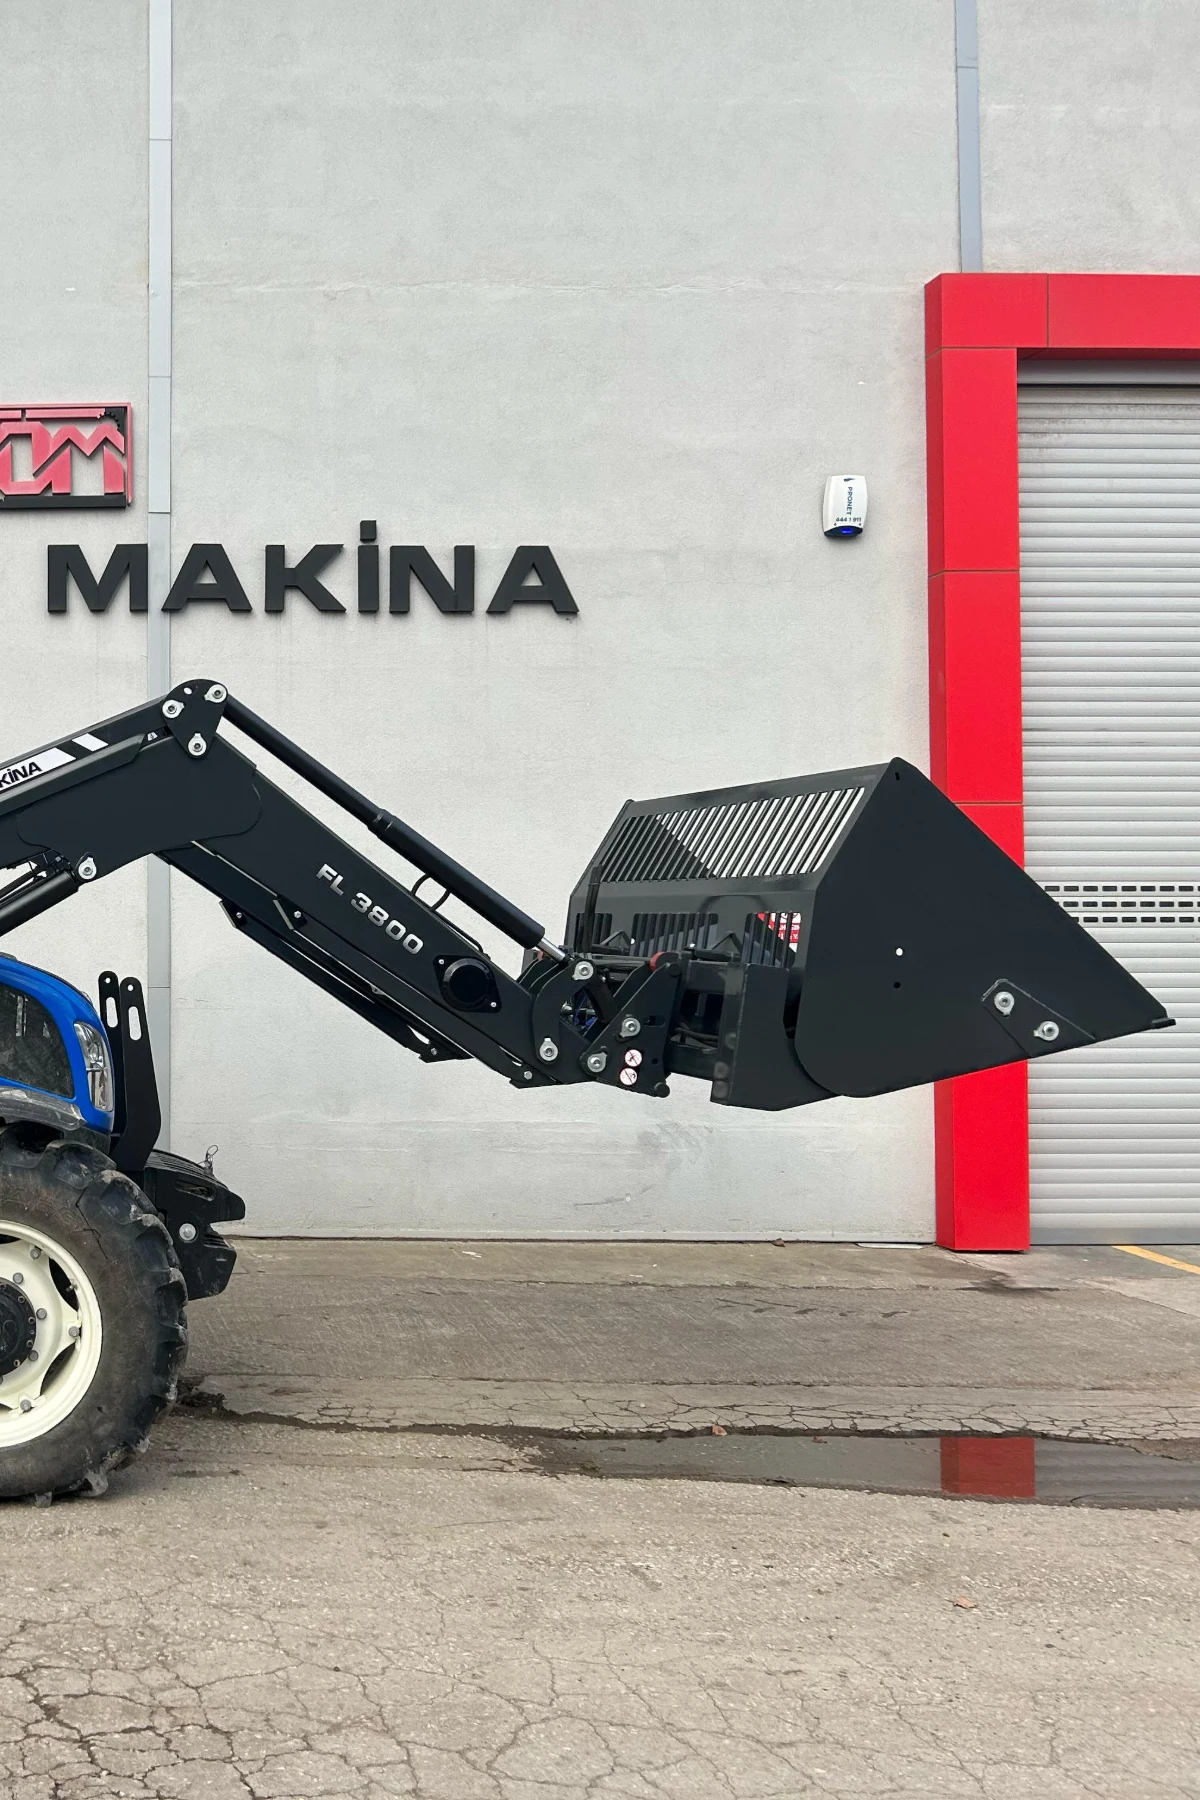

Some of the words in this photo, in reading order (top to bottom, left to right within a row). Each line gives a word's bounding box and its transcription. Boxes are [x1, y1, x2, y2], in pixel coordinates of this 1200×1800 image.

[47, 520, 581, 614] MAKİNA
[316, 863, 344, 896] FL
[350, 892, 424, 955] 3800
